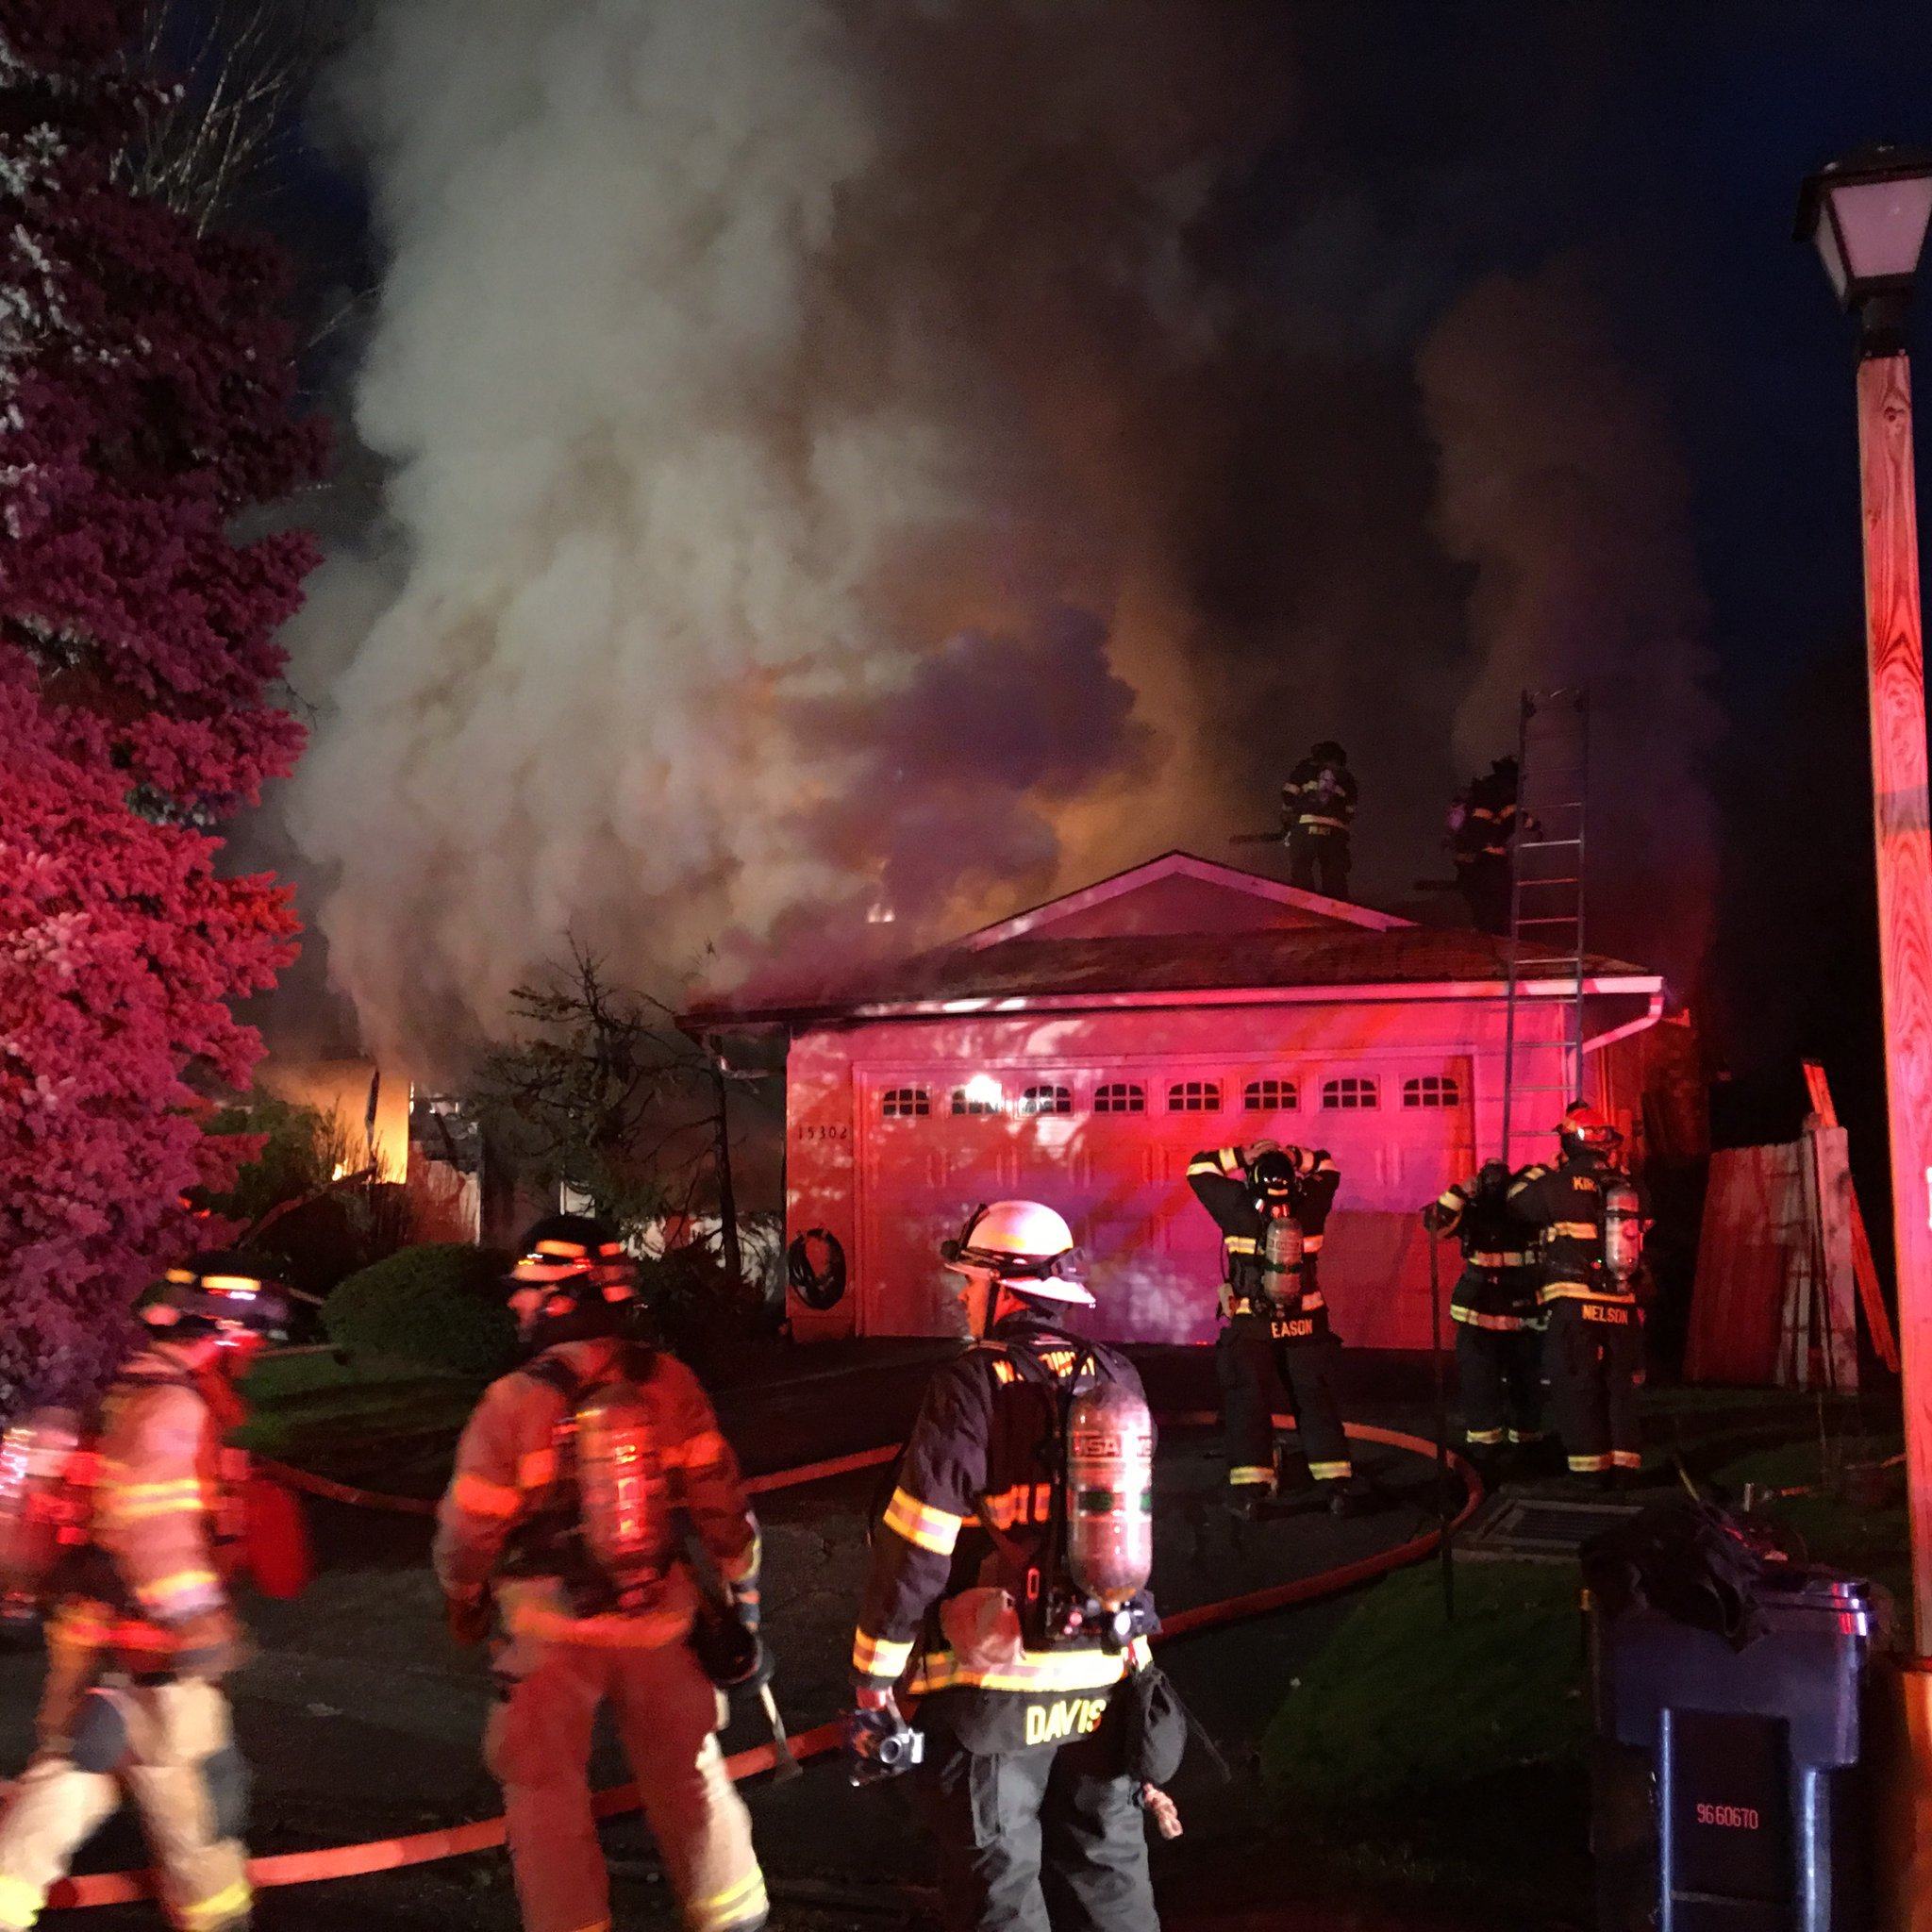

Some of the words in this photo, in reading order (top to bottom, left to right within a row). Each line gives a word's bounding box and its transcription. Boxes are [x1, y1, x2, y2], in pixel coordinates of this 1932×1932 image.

[798, 1124, 847, 1141] 15302
[1582, 1305, 1628, 1325] NELSON
[1271, 1319, 1313, 1338] EASON
[1025, 1699, 1107, 1745] DAVIS
